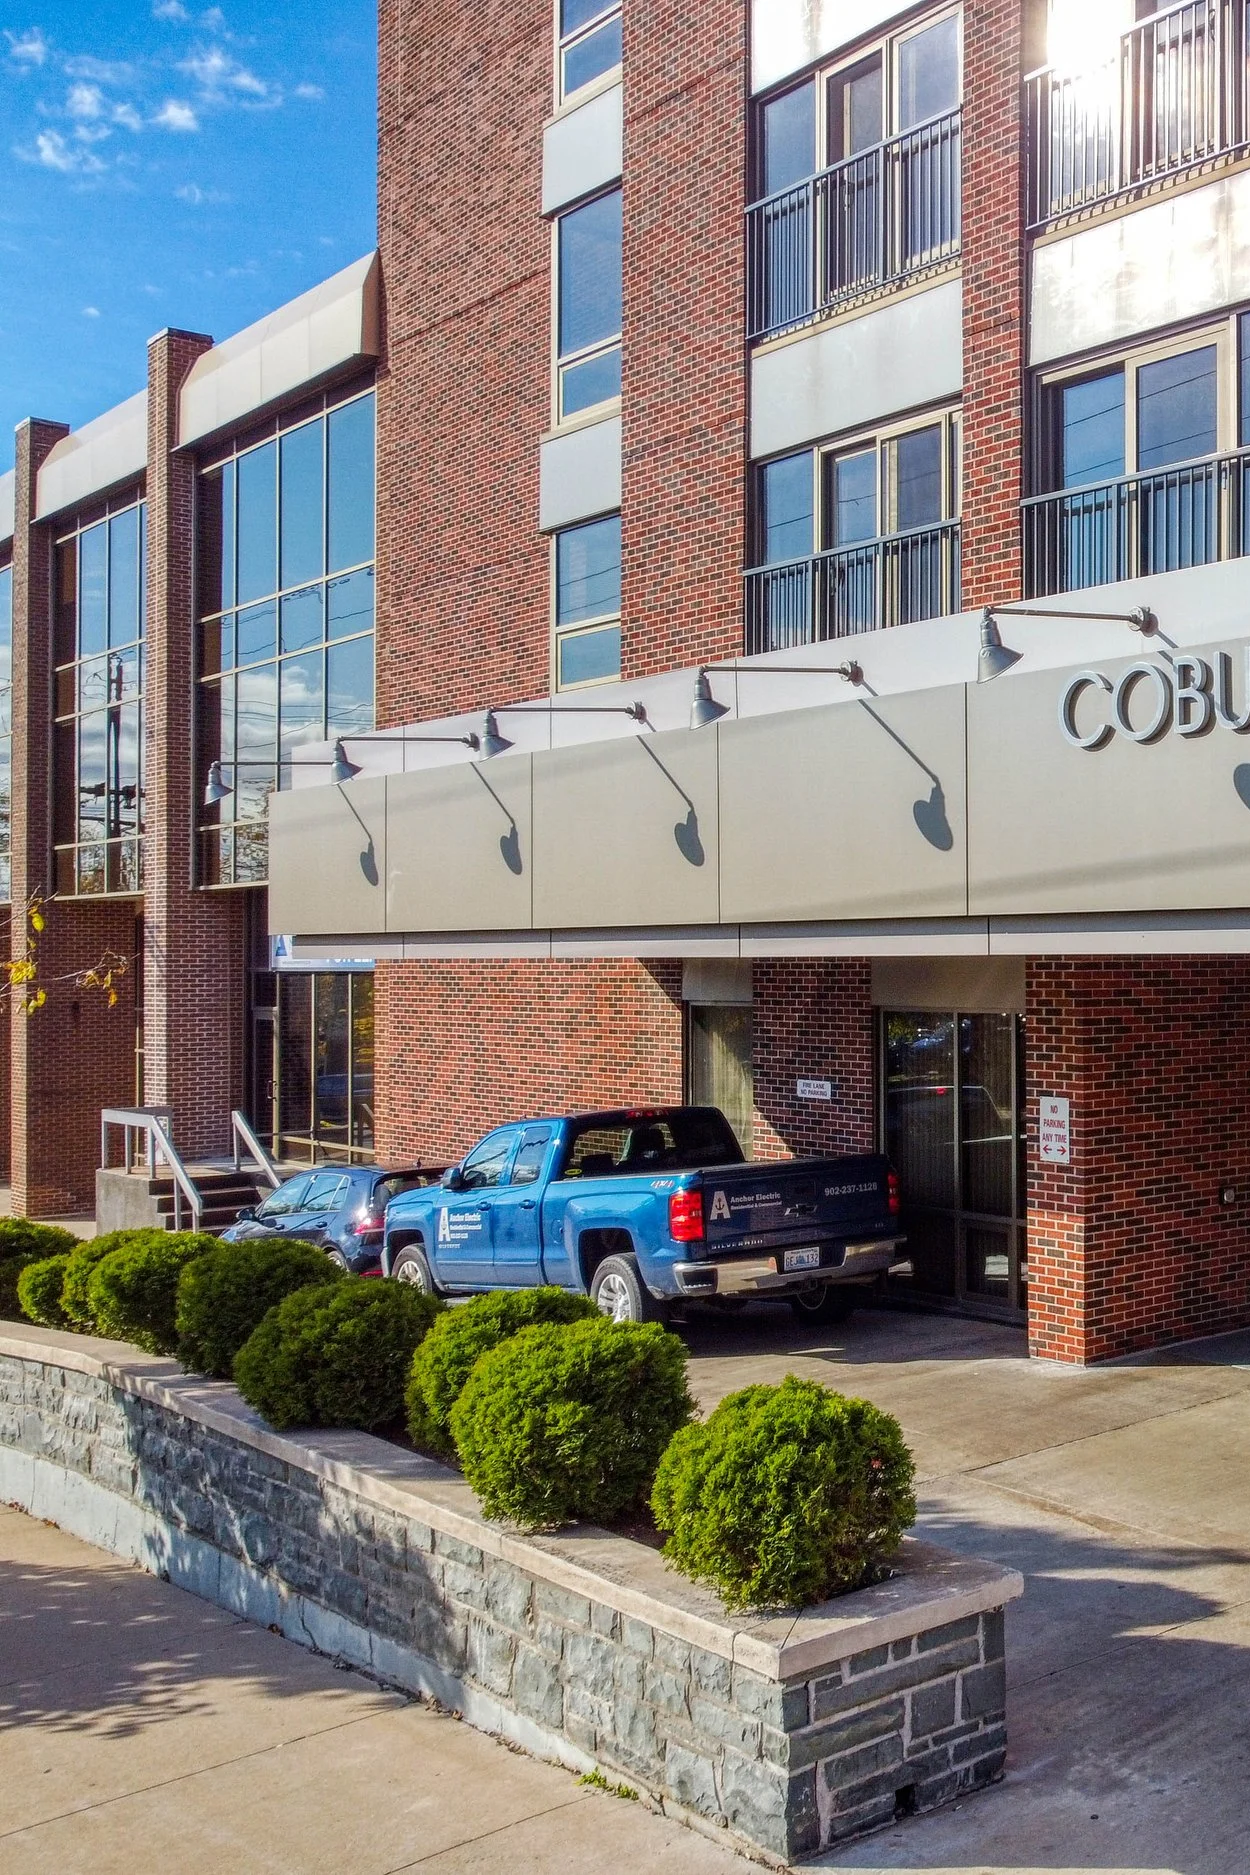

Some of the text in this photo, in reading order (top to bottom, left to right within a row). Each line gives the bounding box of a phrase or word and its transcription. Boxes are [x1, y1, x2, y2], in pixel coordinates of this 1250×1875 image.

[808, 1089, 828, 1097] PARKING
[1050, 1104, 1058, 1114] NO
[1043, 1118, 1066, 1129] PARKING
[1042, 1132, 1067, 1144] ANY TIME
[730, 1191, 781, 1204] Anchor Electric
[806, 1253, 819, 1264] 132
